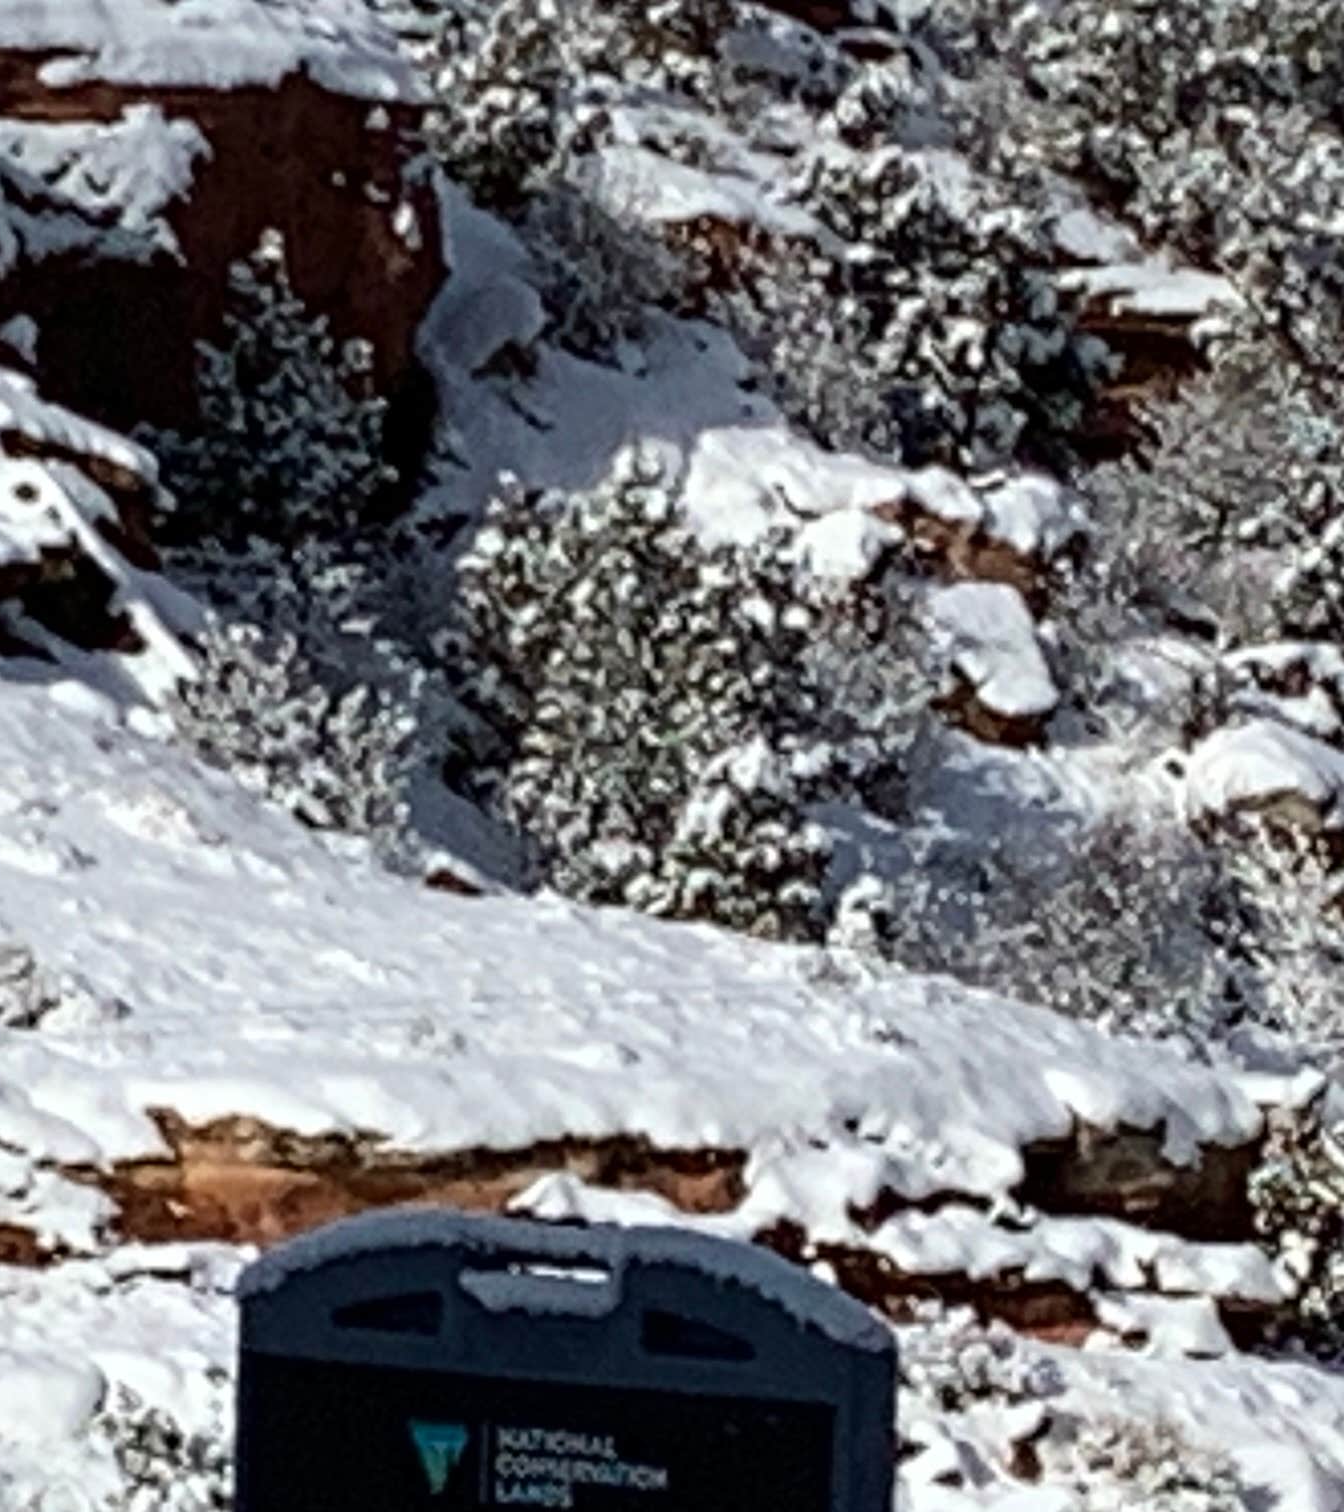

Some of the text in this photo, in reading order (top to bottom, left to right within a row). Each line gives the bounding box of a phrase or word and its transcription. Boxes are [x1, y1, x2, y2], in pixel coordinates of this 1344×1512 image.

[496, 1426, 618, 1459] NATIONAL
[493, 1452, 669, 1490] CONSERVATION
[494, 1479, 574, 1509] LANDS
